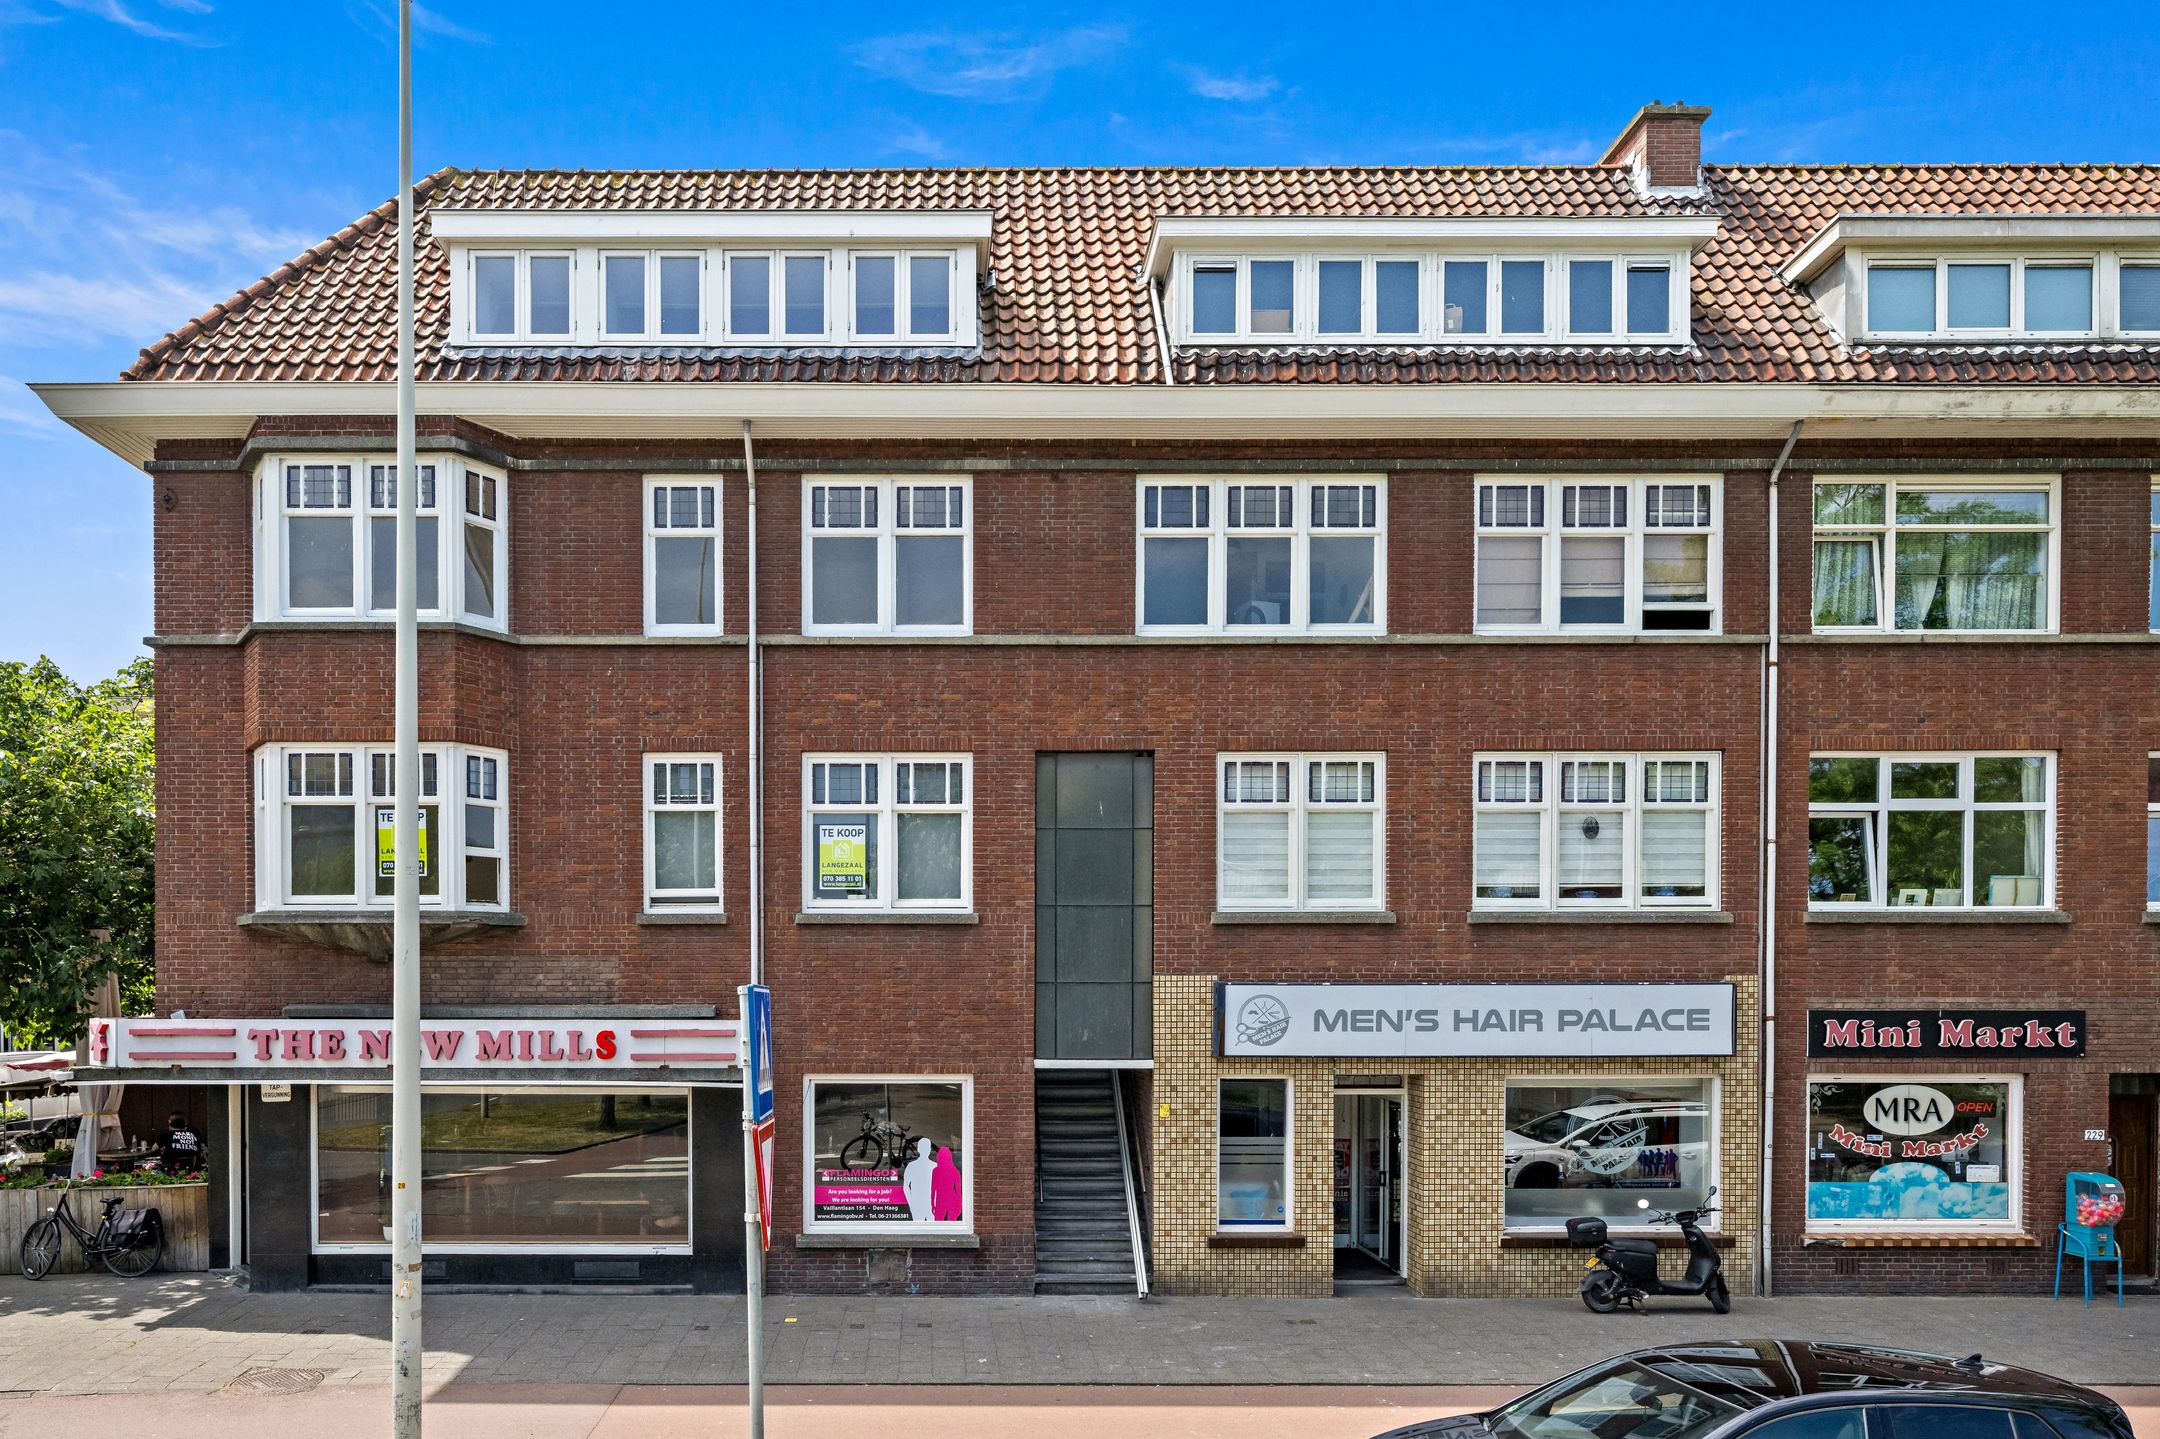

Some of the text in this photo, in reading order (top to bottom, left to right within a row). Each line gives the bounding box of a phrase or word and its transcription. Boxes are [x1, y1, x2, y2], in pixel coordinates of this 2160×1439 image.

[380, 813, 394, 822] TE
[821, 828, 864, 837] TE KOOP
[1271, 1021, 1288, 1032] HAIR
[1313, 1008, 1711, 1033] MEN'S HAIR PALACE
[1259, 1030, 1283, 1045] PALACE
[1823, 1018, 2077, 1048] Mini Markt
[247, 1028, 617, 1062] THE NW MILLS
[1874, 1097, 1944, 1122] MRA
[1956, 1102, 1994, 1113] OPEN
[1828, 1123, 1892, 1158] Mini
[1902, 1122, 1990, 1158] Markt
[2086, 1130, 2104, 1140] 229
